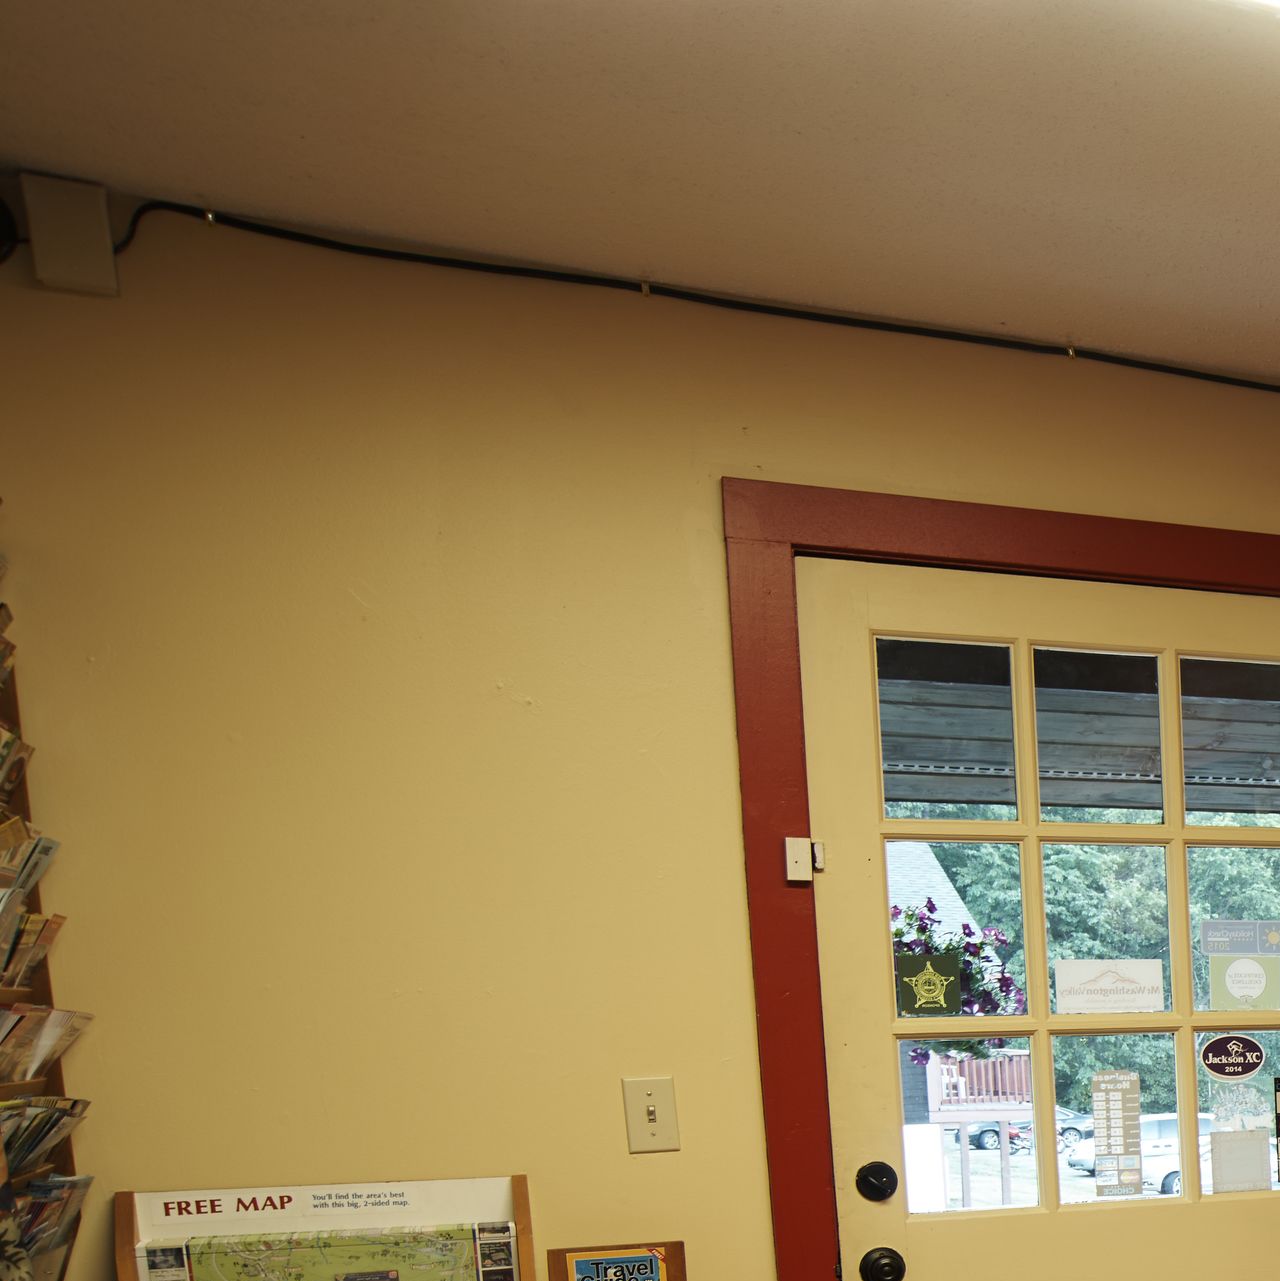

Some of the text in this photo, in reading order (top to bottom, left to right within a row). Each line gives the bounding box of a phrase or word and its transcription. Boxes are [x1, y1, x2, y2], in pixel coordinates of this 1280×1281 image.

[1205, 1052, 1261, 1064] Jackson XC
[312, 1193, 332, 1201] You'll
[335, 1192, 350, 1201] find
[352, 1192, 364, 1200] the
[366, 1191, 387, 1199] area's
[163, 1195, 293, 1217] FREE MAP
[312, 1199, 410, 1210] with this big, 2-sided map.
[590, 1258, 655, 1279] Travel
